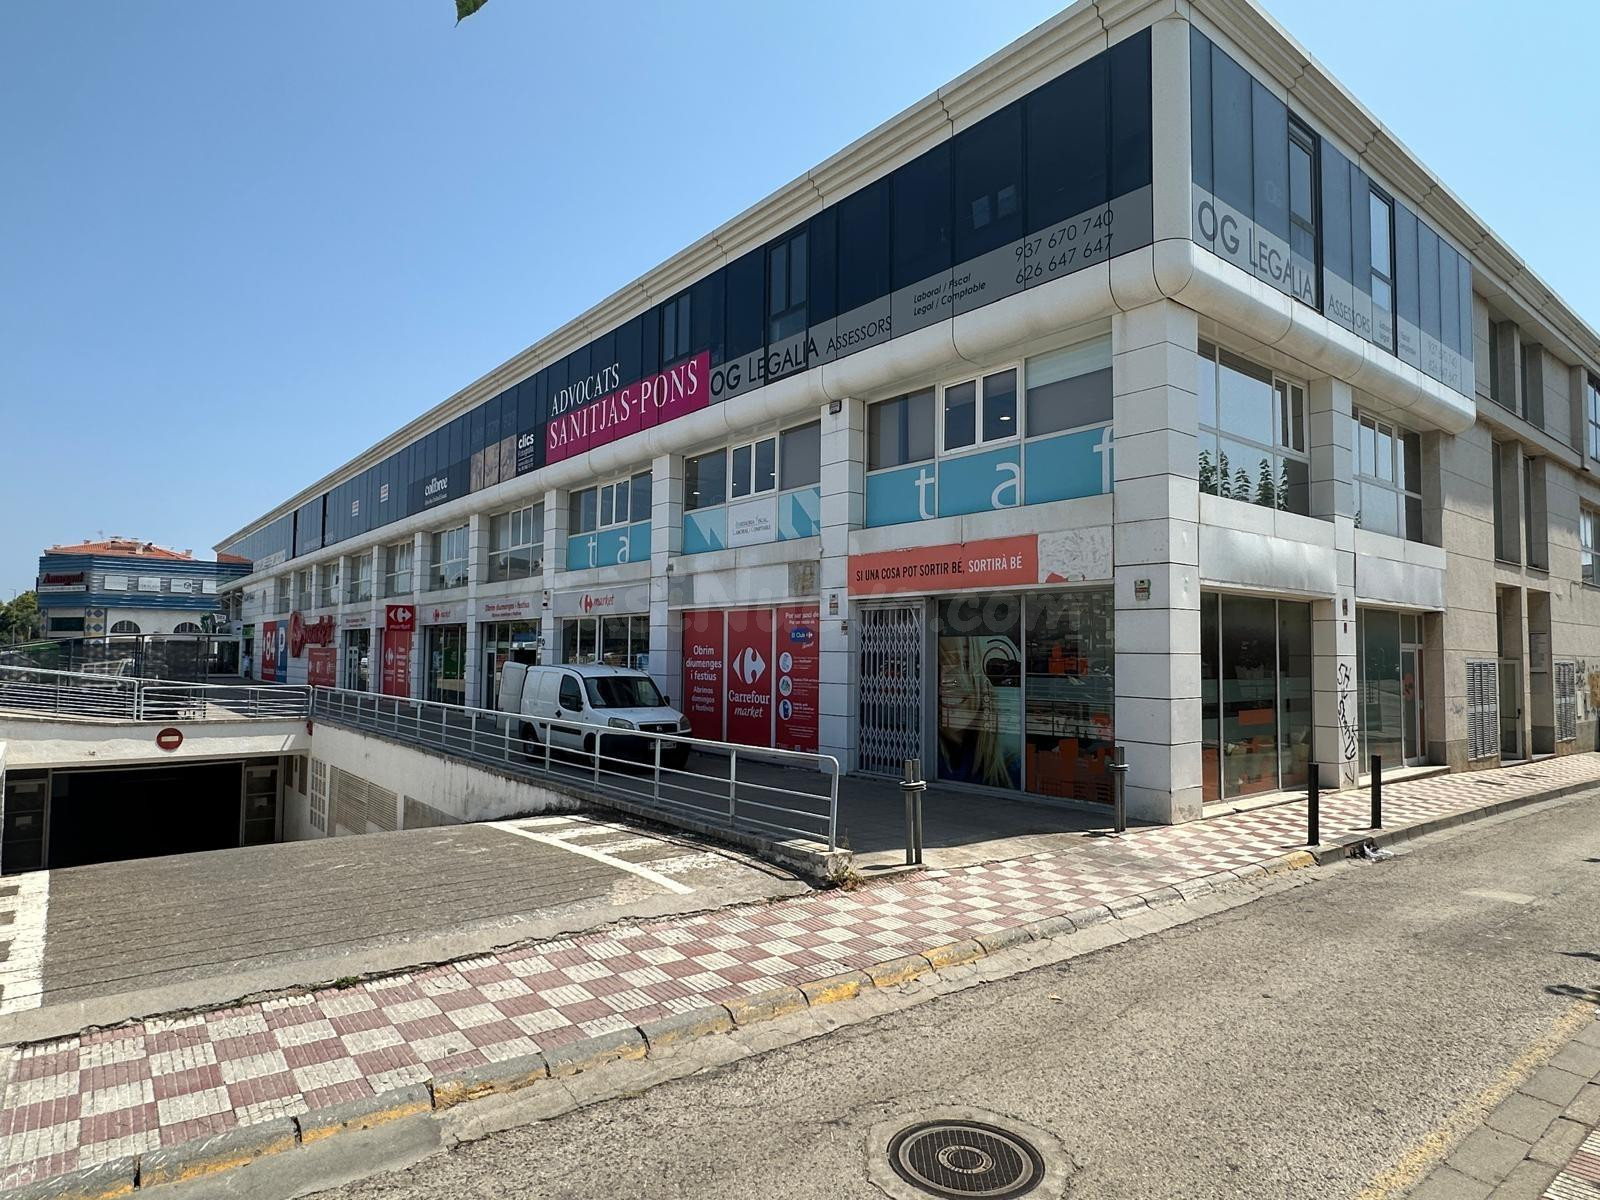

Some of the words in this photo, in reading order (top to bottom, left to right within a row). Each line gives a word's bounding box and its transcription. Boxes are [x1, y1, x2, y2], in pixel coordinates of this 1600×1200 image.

[1015, 238, 1042, 263] 937
[1048, 224, 1076, 249] 670
[1082, 208, 1114, 235] 740
[1015, 261, 1043, 285] 626
[1048, 247, 1076, 272] 647
[1083, 233, 1114, 258] 647
[1198, 200, 1240, 255] OG
[1249, 227, 1314, 305] LEGALIA
[913, 283, 942, 304] Laboral
[913, 300, 934, 316] Legal
[941, 281, 986, 305] Comptable
[710, 364, 741, 397] OG
[749, 336, 819, 384] LEGALIA
[825, 315, 892, 354] ASSESSORS
[551, 362, 620, 417] ADVOCATS
[550, 359, 698, 449] SANITJAS-PONS
[518, 433, 535, 449] clics
[856, 569, 863, 582] SI
[864, 568, 880, 582] UNA
[881, 565, 901, 581] COSA
[902, 563, 918, 579] POT
[919, 560, 949, 577] SORTIR
[951, 557, 965, 575] BÉ,
[968, 553, 1008, 574] SORTIRÀ
[1009, 552, 1023, 570] BÉ
[593, 593, 615, 608] market
[693, 644, 715, 656] Obrim
[685, 657, 722, 671] diumenges
[694, 670, 717, 681] festius
[728, 689, 771, 705] Carrefour
[734, 706, 764, 719] market
